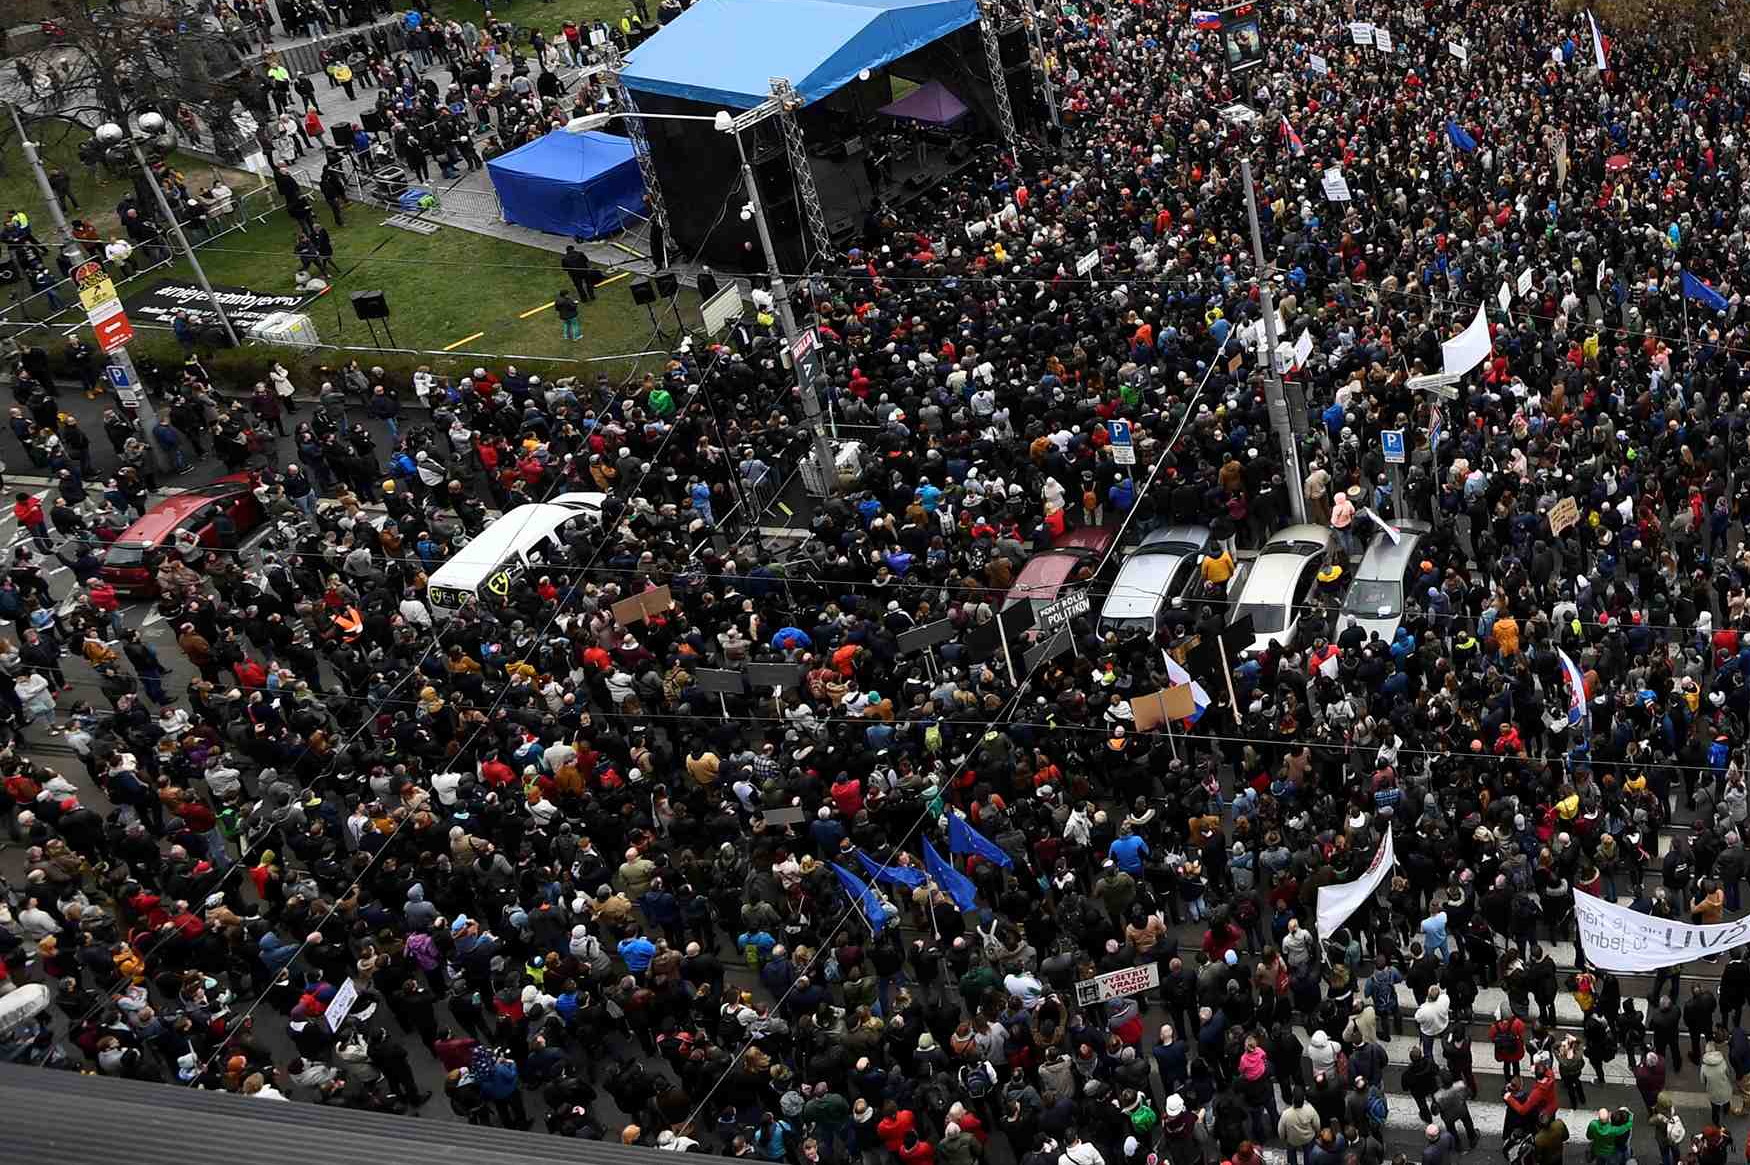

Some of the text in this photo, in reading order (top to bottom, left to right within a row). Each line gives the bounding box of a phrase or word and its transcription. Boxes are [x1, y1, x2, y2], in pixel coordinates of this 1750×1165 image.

[112, 367, 122, 380] P
[1113, 423, 1122, 437] P
[1387, 434, 1397, 447] P
[1104, 982, 1151, 999] A FONDY
